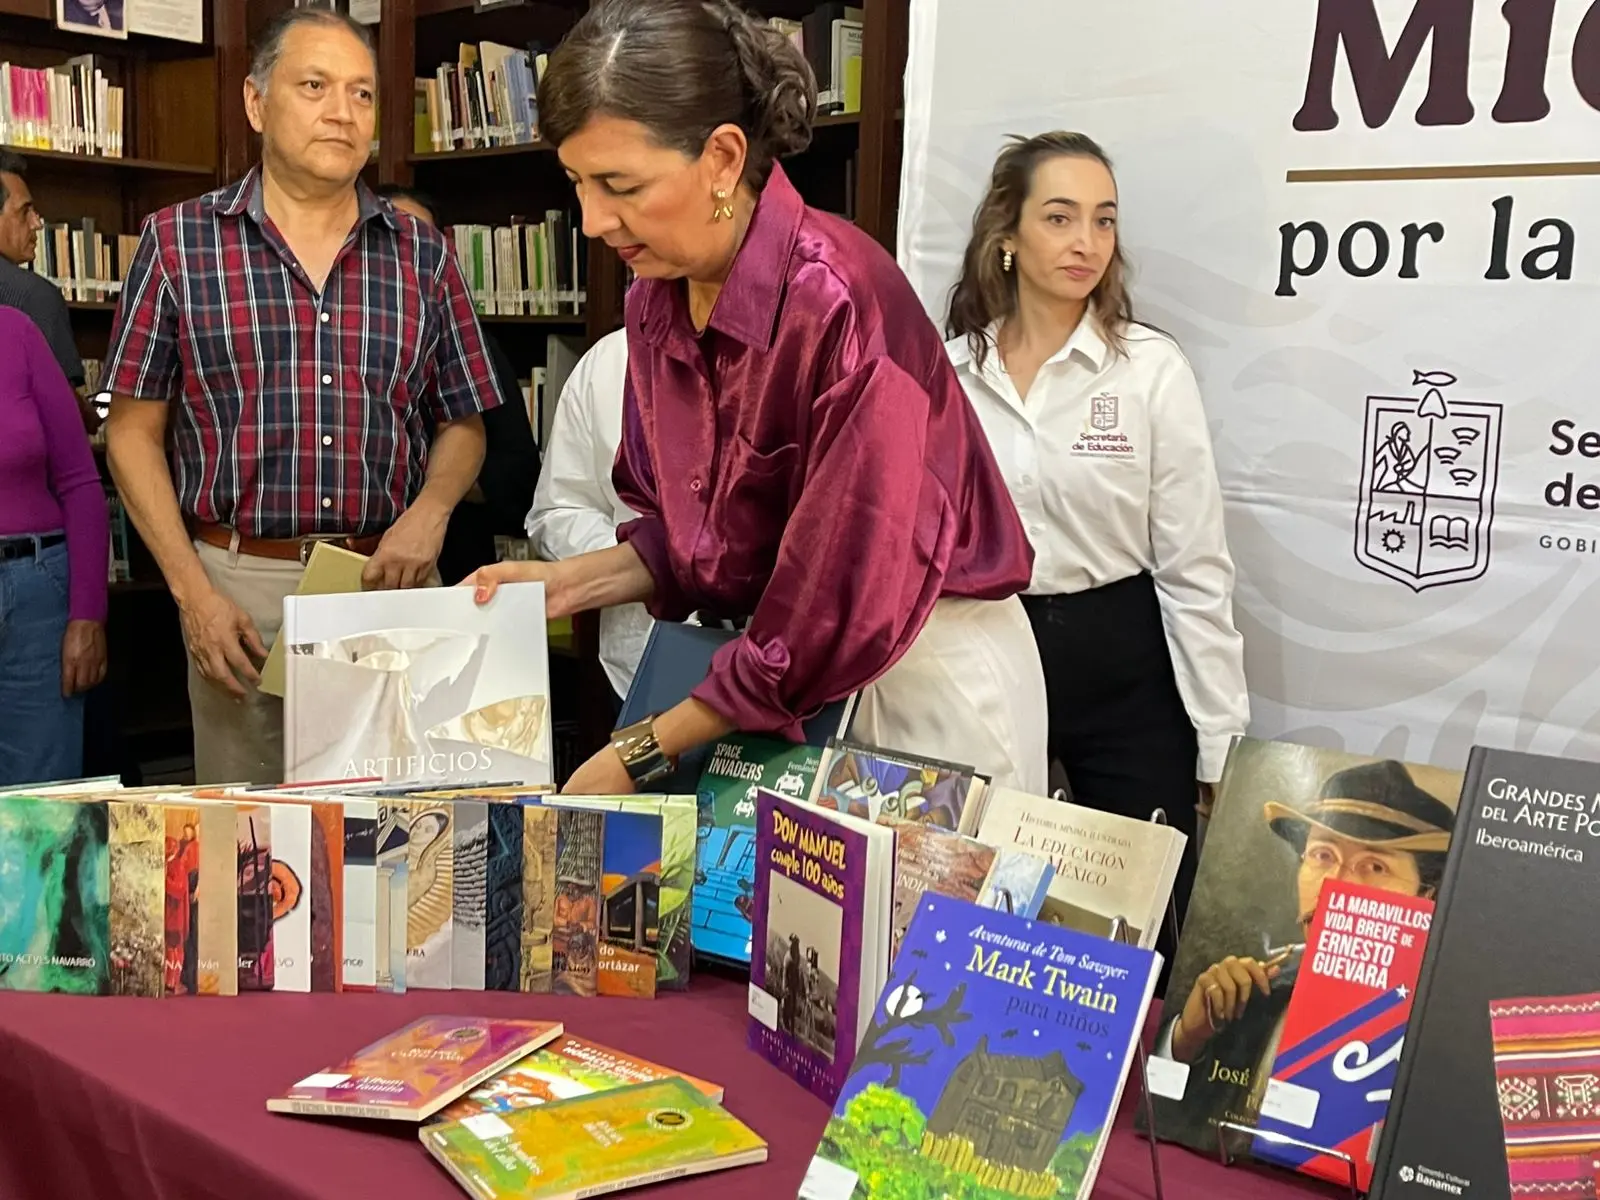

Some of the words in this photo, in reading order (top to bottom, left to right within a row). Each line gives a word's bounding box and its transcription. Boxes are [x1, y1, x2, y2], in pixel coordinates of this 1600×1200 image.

[1275, 220, 1444, 296] por
[1484, 195, 1575, 280] la
[1072, 442, 1085, 451] de
[1087, 443, 1134, 453] Educación
[1080, 432, 1128, 442] Secretaría
[1549, 419, 1600, 458] Se
[1544, 472, 1600, 510] de
[1539, 535, 1597, 553] GOBI
[343, 747, 492, 781] ARTIFICIOS
[708, 757, 764, 781] INVADERS
[714, 743, 743, 760] SPACE
[1487, 778, 1586, 812] GRANDES
[1481, 806, 1508, 823] DEL
[1513, 803, 1570, 832] ARTE
[1574, 812, 1600, 837] PO
[772, 809, 799, 845] DON
[798, 827, 847, 871] MANUEL
[1013, 826, 1035, 849] LA
[1040, 837, 1128, 871] EDUCACIÓN
[1476, 827, 1584, 864] Iberoamérica
[770, 847, 800, 877] cumple
[802, 855, 821, 885] 100
[821, 872, 845, 900] años
[1048, 855, 1108, 888] MÉXICO
[1328, 891, 1346, 912] LA
[1347, 895, 1432, 931] MARAVILLOS
[1324, 910, 1354, 933] VIDA
[1355, 917, 1401, 945] BREVE
[1401, 932, 1419, 948] DE
[51, 955, 96, 968] NAVARRO
[599, 945, 615, 957] do
[968, 924, 1031, 953] Aventuras
[1031, 941, 1048, 958] de
[1049, 944, 1077, 966] Tom
[1078, 953, 1129, 980] Sawyer:
[1317, 929, 1395, 968] ERNESTO
[598, 960, 640, 973] ortázar
[965, 943, 1037, 990] Mark
[1043, 963, 1119, 1015] Twain
[1312, 951, 1390, 990] GUEVARA
[1005, 995, 1050, 1021] para
[1055, 1005, 1112, 1038] niños
[1207, 1059, 1251, 1087] JOSÉ
[1416, 1172, 1463, 1196] Banamex
